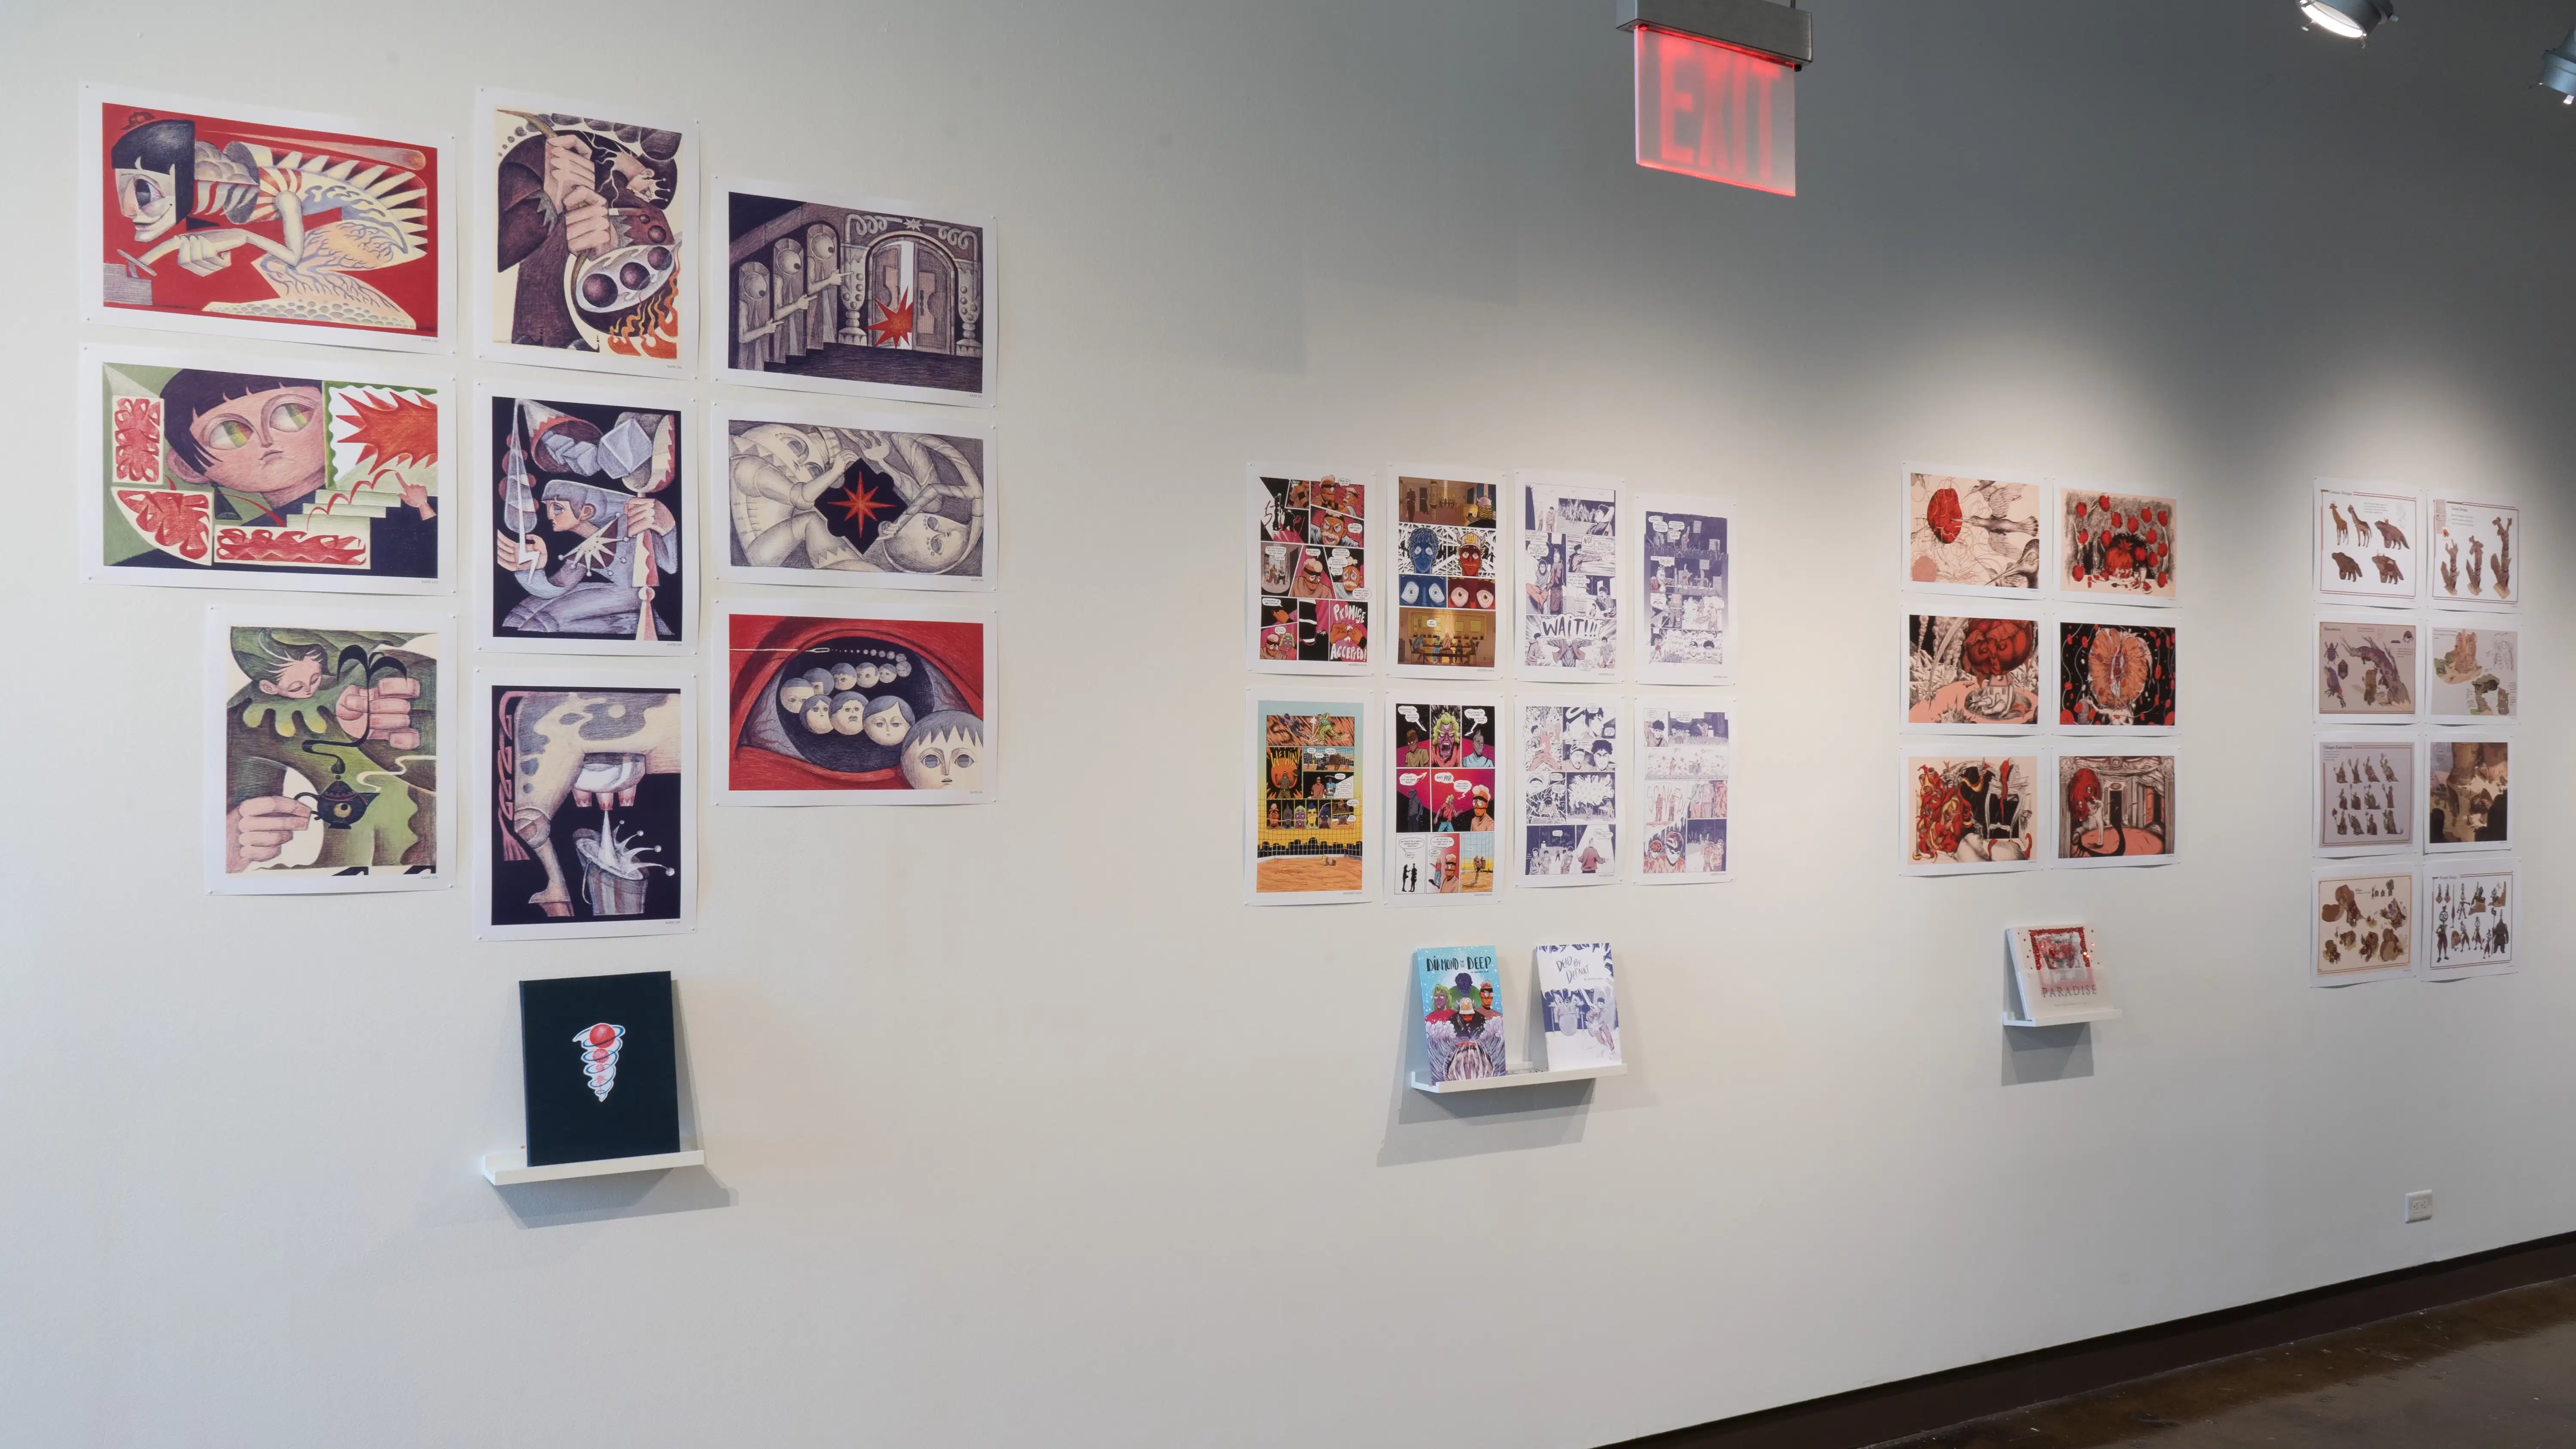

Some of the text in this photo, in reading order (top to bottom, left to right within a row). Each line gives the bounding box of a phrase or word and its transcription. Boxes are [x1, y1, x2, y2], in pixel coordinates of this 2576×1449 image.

[1659, 36, 1781, 179] EXIT
[1330, 643, 1367, 662] ACCEPTED!
[1270, 750, 1283, 768] WE
[1284, 750, 1301, 768] WIN!
[1467, 956, 1492, 970] DEEP
[2041, 984, 2097, 998] PARADISE
